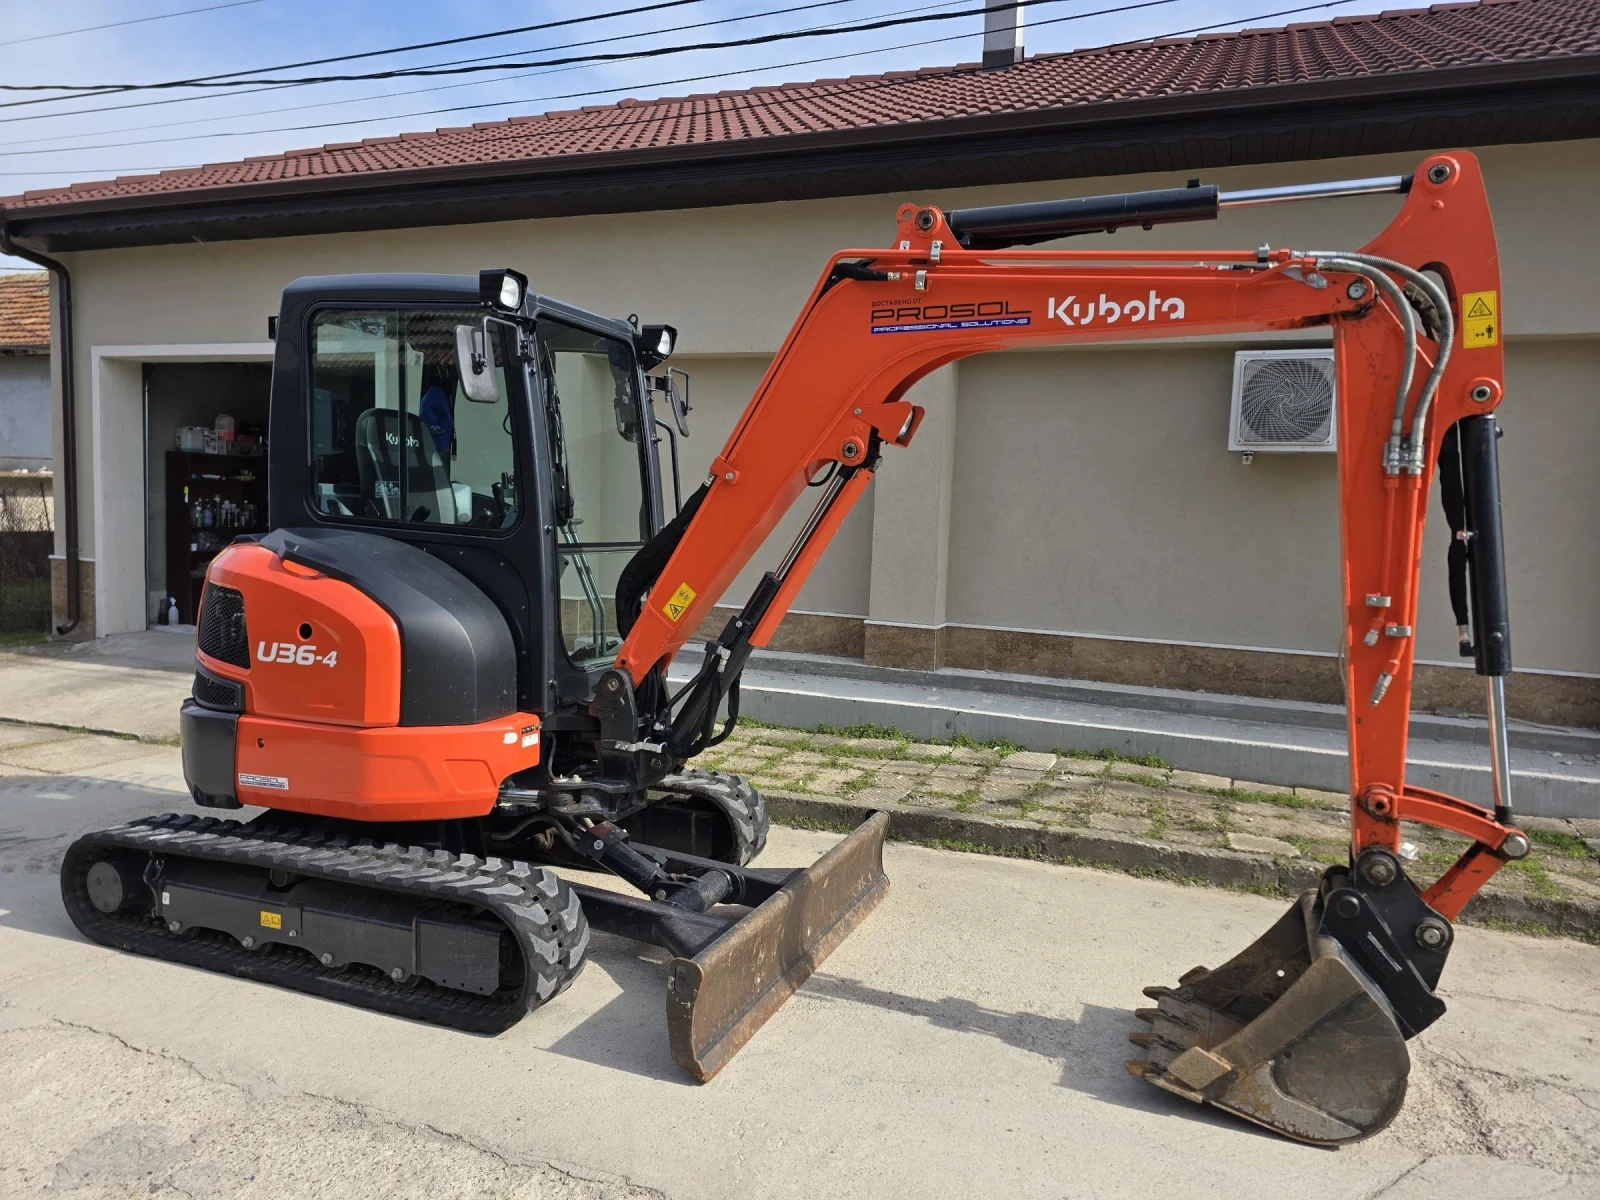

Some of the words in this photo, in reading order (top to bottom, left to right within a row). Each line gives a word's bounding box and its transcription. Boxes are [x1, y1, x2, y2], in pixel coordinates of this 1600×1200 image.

[871, 298, 911, 308] ДОСТАВЕНО
[871, 301, 1032, 323] PROSOL
[1047, 290, 1185, 325] Kubota
[873, 322, 958, 333] PROFESSIONAL
[960, 318, 1029, 328] SOLUTIONS
[256, 641, 338, 668] U36-4
